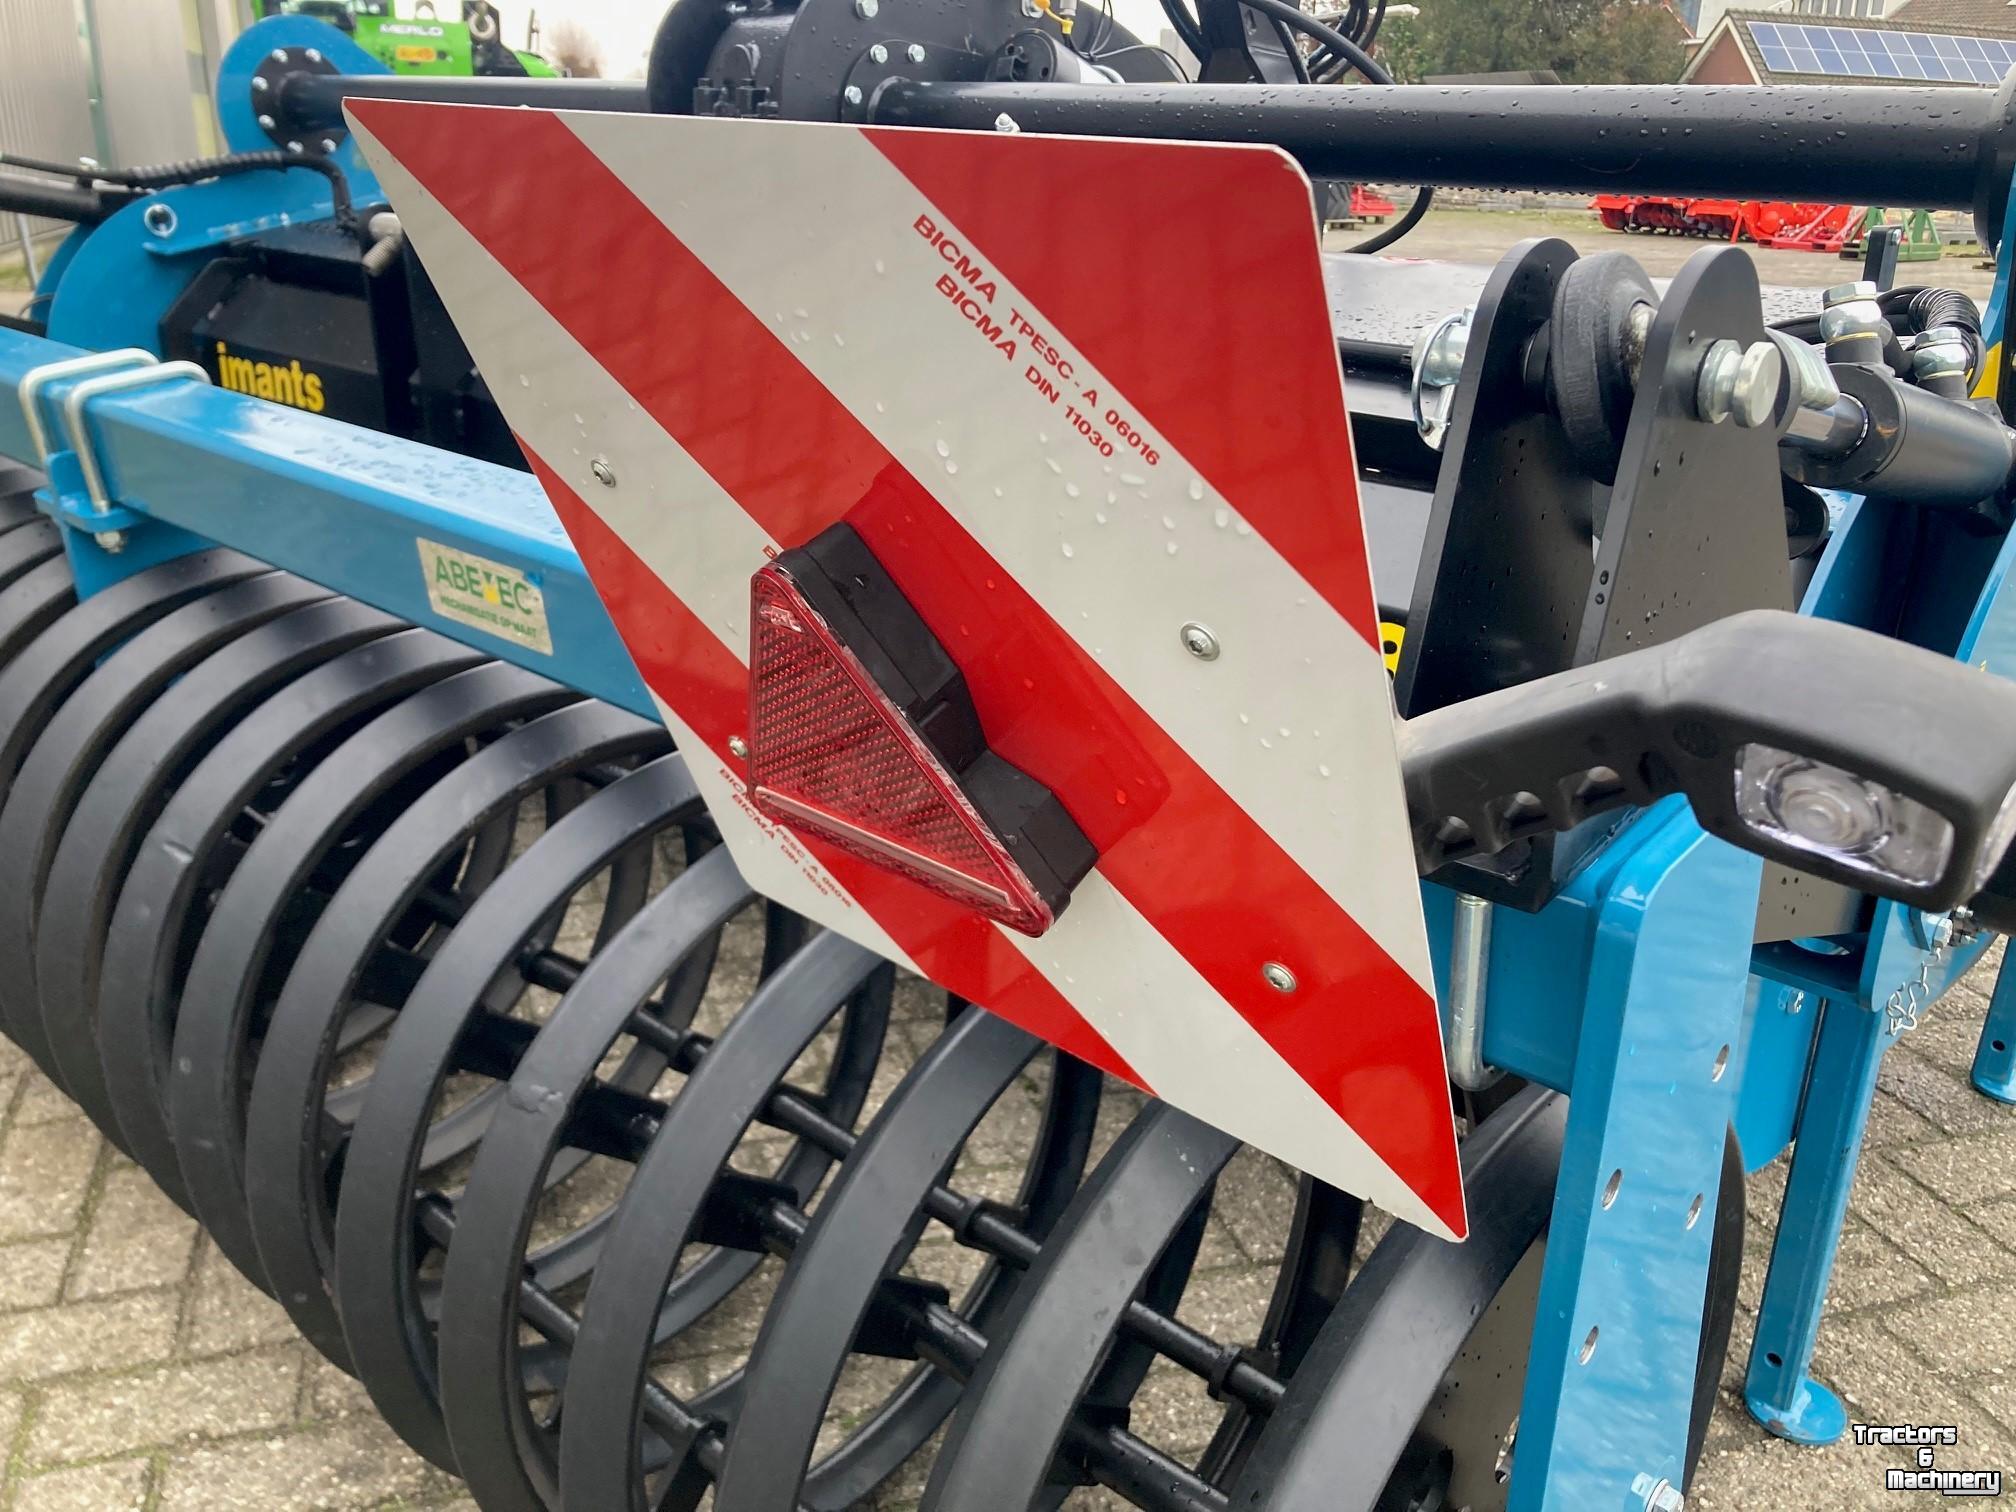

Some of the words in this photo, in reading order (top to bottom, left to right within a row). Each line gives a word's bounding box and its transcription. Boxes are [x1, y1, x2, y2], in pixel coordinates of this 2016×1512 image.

[380, 24, 443, 37] MERLO
[913, 214, 998, 304] BICMA
[1010, 308, 1074, 380] TPESC
[1105, 409, 1160, 466] 06016
[935, 274, 1017, 361] BICMA
[1025, 365, 1060, 404] DIN
[1064, 404, 1114, 458] 11030
[216, 341, 325, 412] imants
[732, 794, 776, 840] BICMA
[780, 844, 799, 864] DIN
[773, 823, 806, 858] PESC
